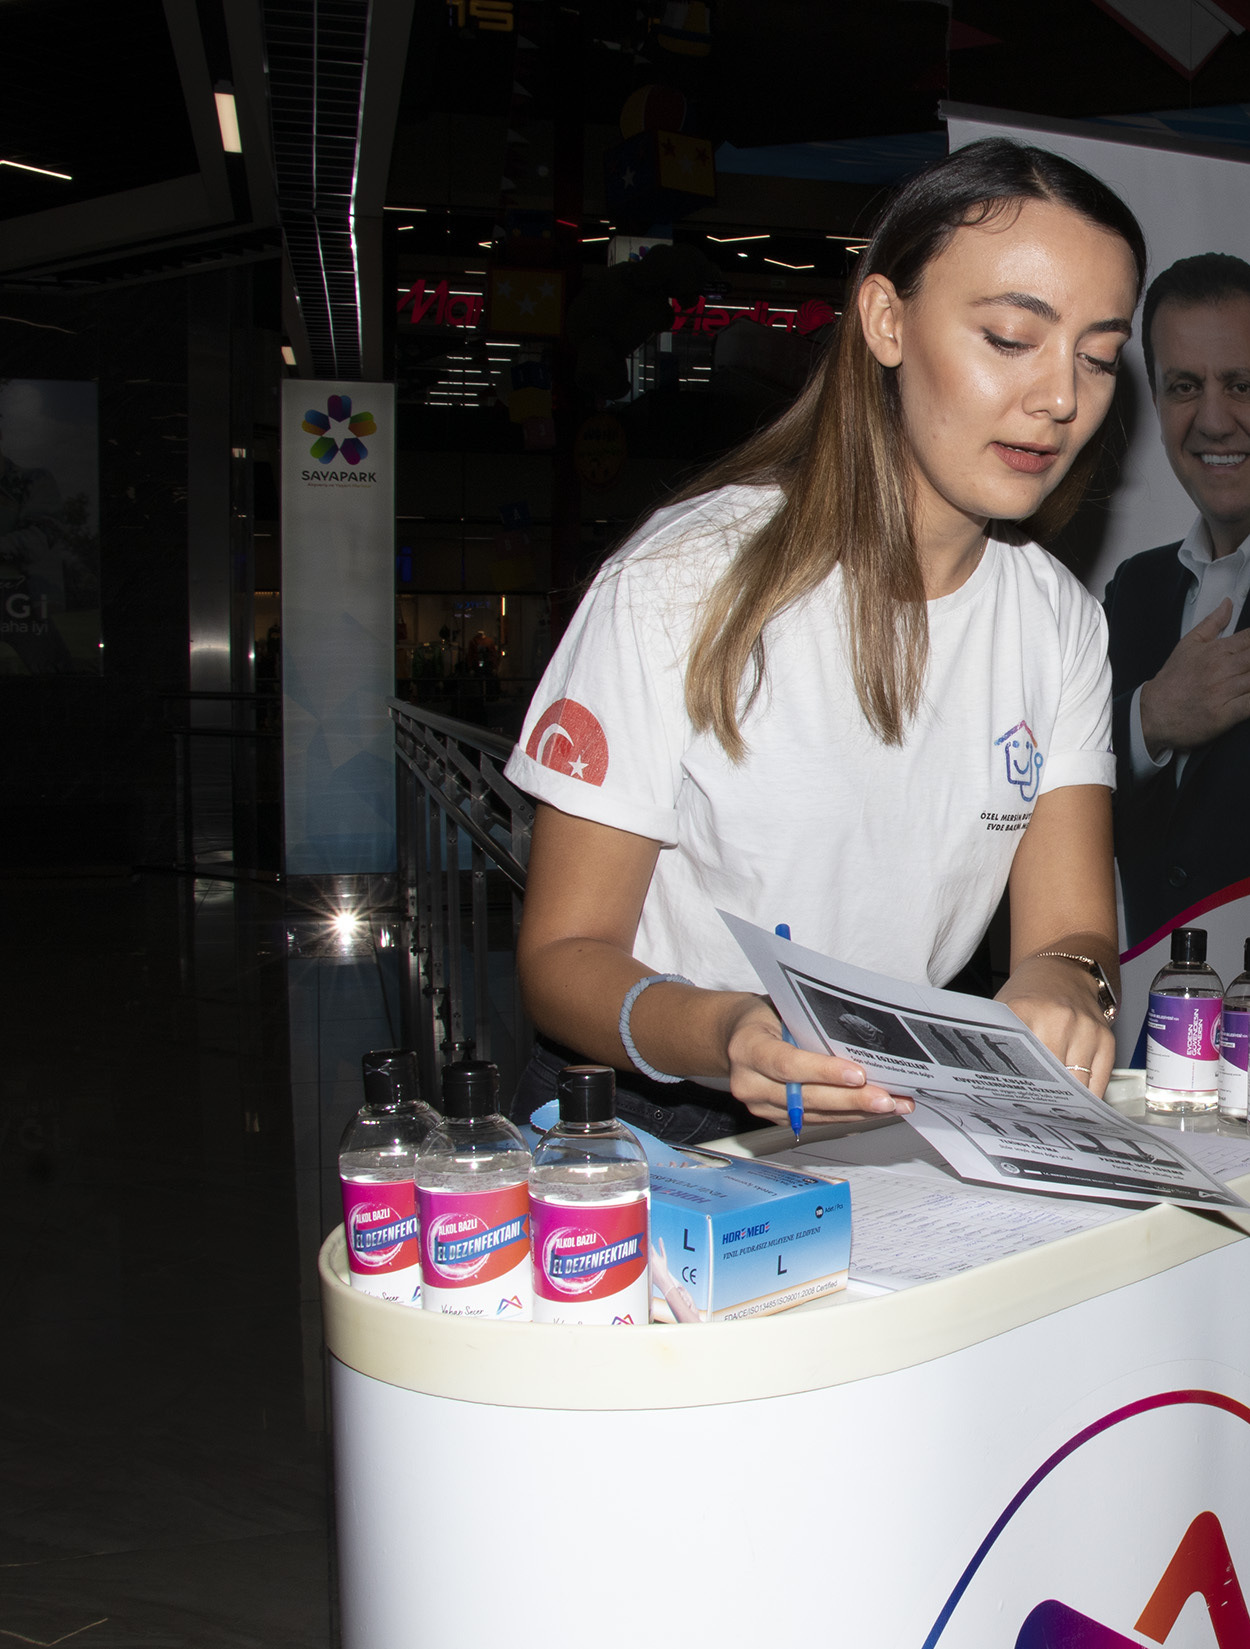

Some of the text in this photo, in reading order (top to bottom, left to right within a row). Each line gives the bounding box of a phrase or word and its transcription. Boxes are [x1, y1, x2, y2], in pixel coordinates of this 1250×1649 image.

[301, 470, 376, 483] SAYAPARK
[980, 810, 999, 821] ÖZEL
[987, 823, 1005, 832] EVDE
[355, 1208, 390, 1225] ALKOL BAZLI
[438, 1219, 478, 1236] ALKOL BAZLI
[356, 1234, 365, 1249] EL
[437, 1246, 447, 1261] EL
[449, 1221, 521, 1261] DEZENFEKTANI
[555, 1233, 597, 1249] ALKOL BAZLI
[683, 1228, 695, 1252] L
[552, 1238, 638, 1274] EL DEZENFEKTANI
[777, 1255, 787, 1275] L
[682, 1266, 697, 1284] CE
[816, 1280, 838, 1293] Certified
